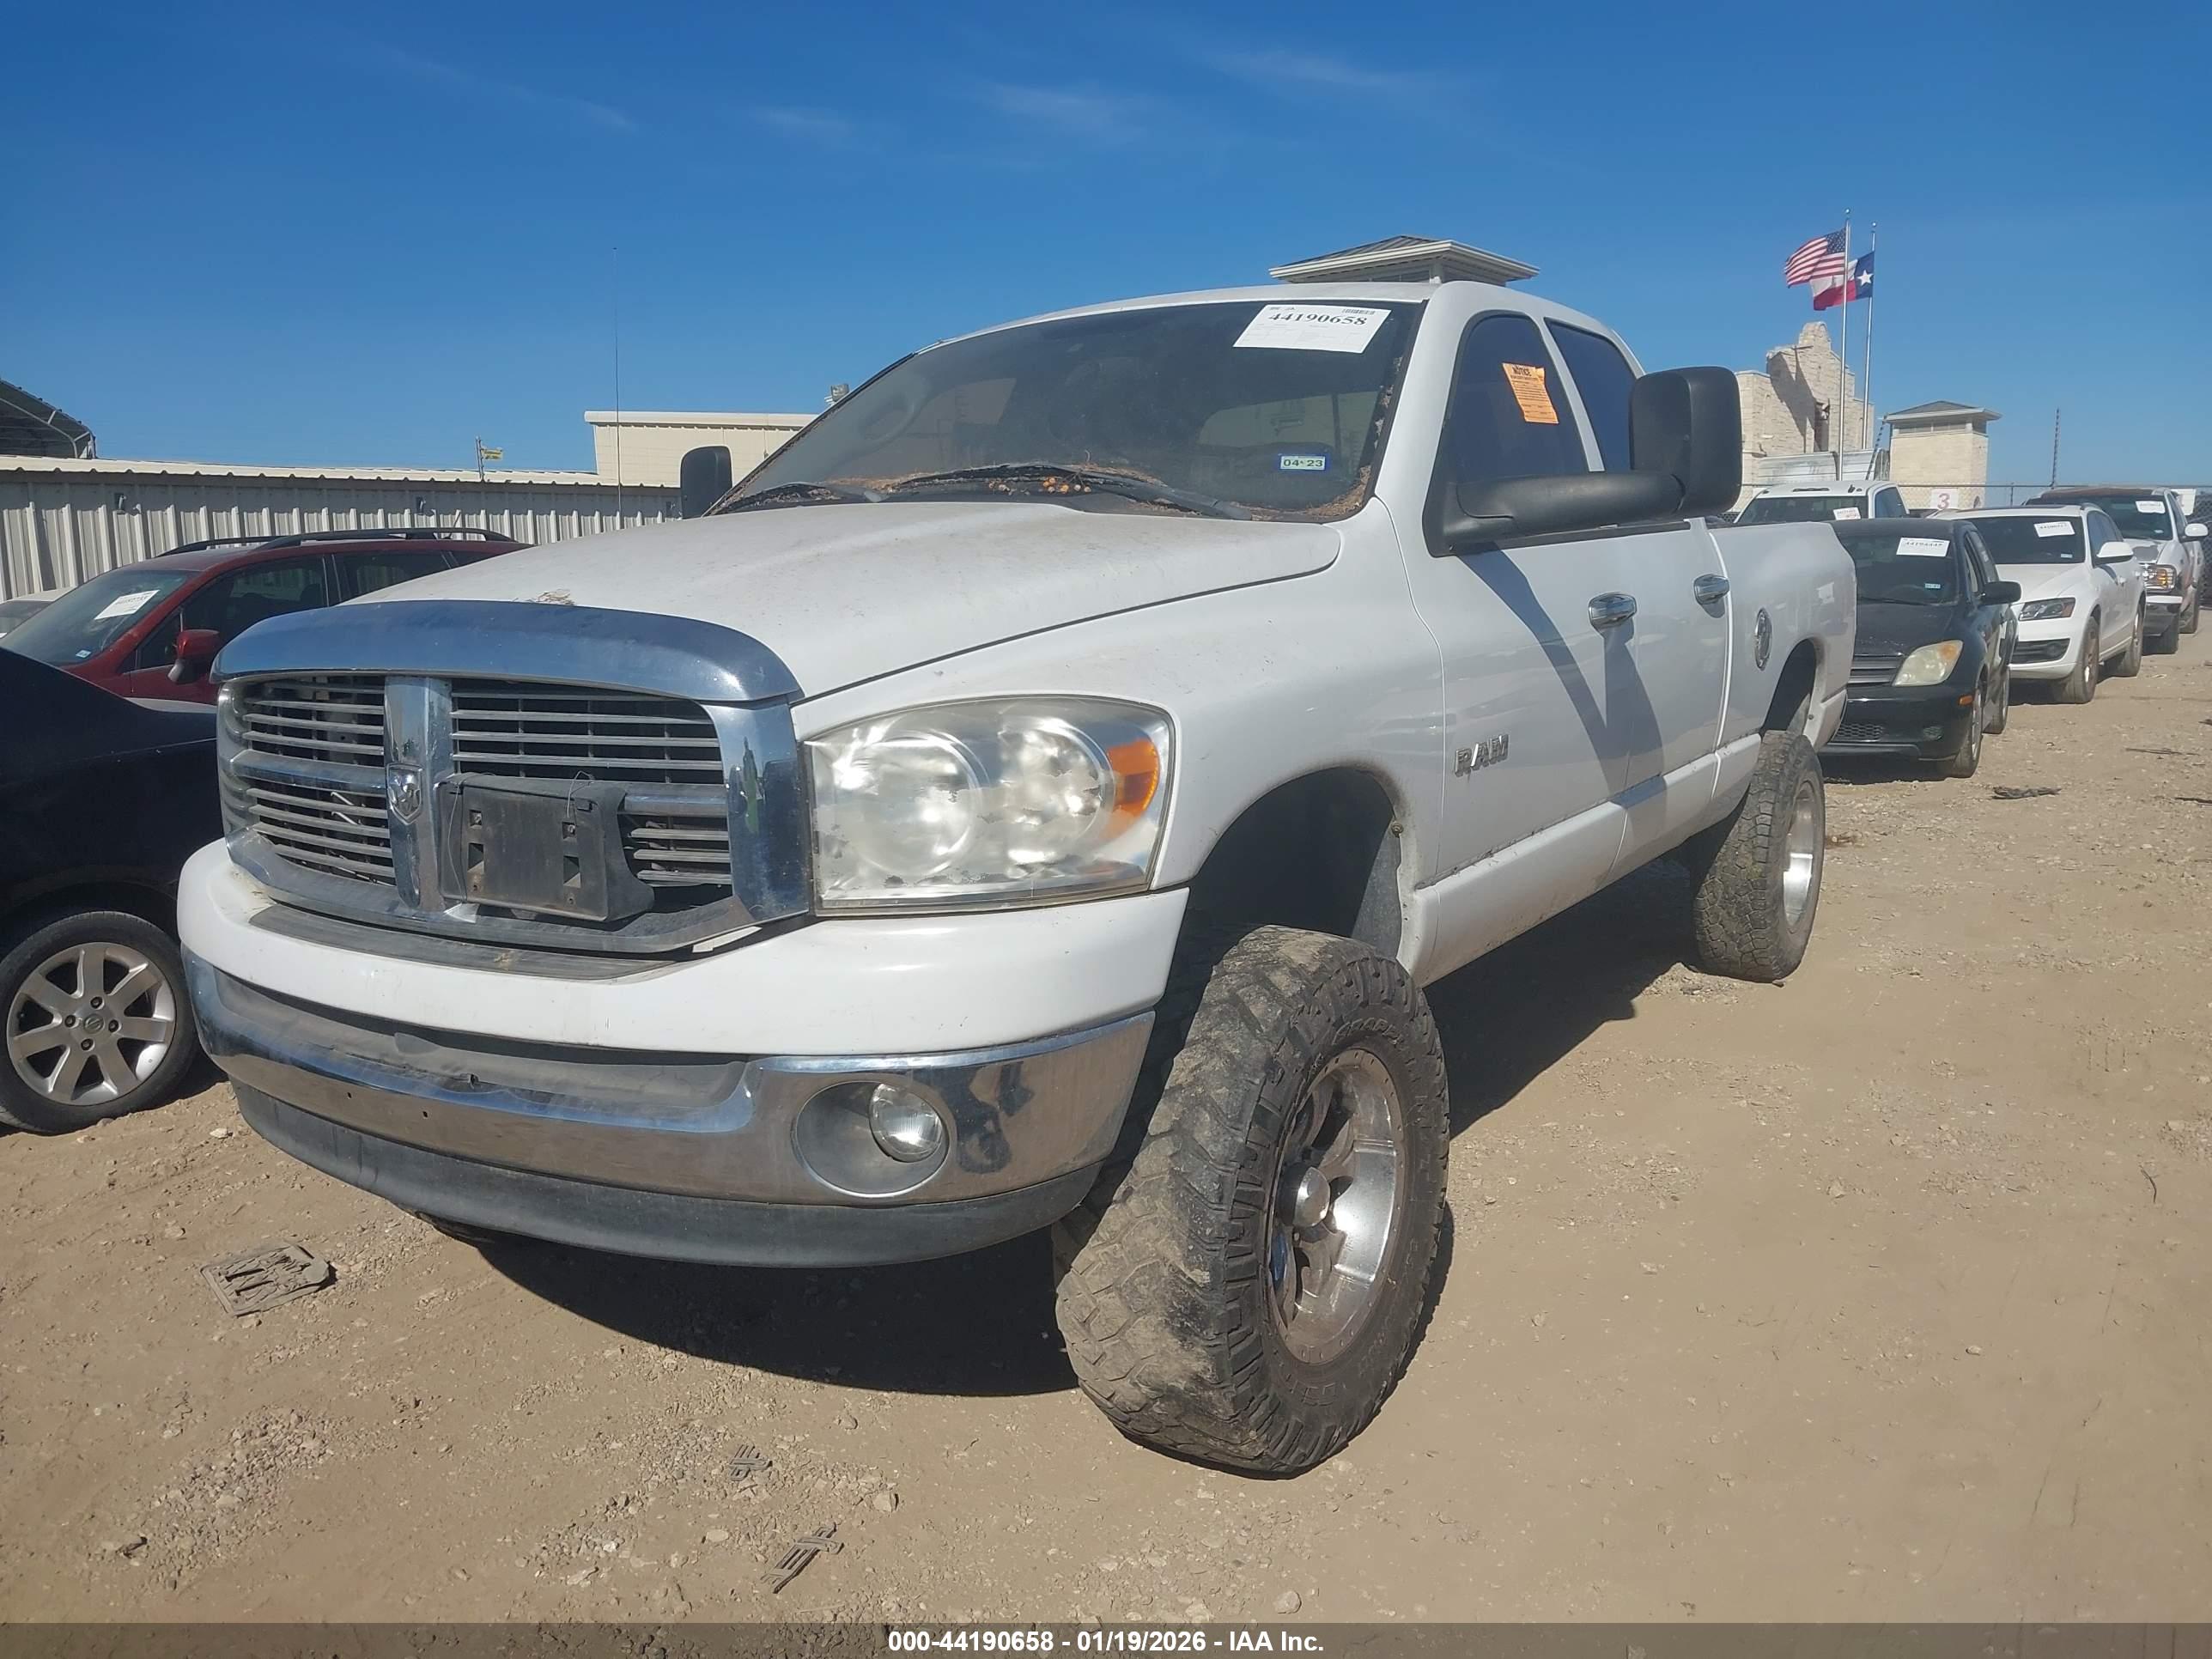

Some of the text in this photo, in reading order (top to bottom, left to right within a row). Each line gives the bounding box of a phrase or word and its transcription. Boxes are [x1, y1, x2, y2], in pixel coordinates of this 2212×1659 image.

[1268, 313, 1368, 325] 44190658
[1283, 459, 1323, 467] 04 23
[1937, 493, 1951, 509] 3
[1455, 733, 1509, 778] RAM
